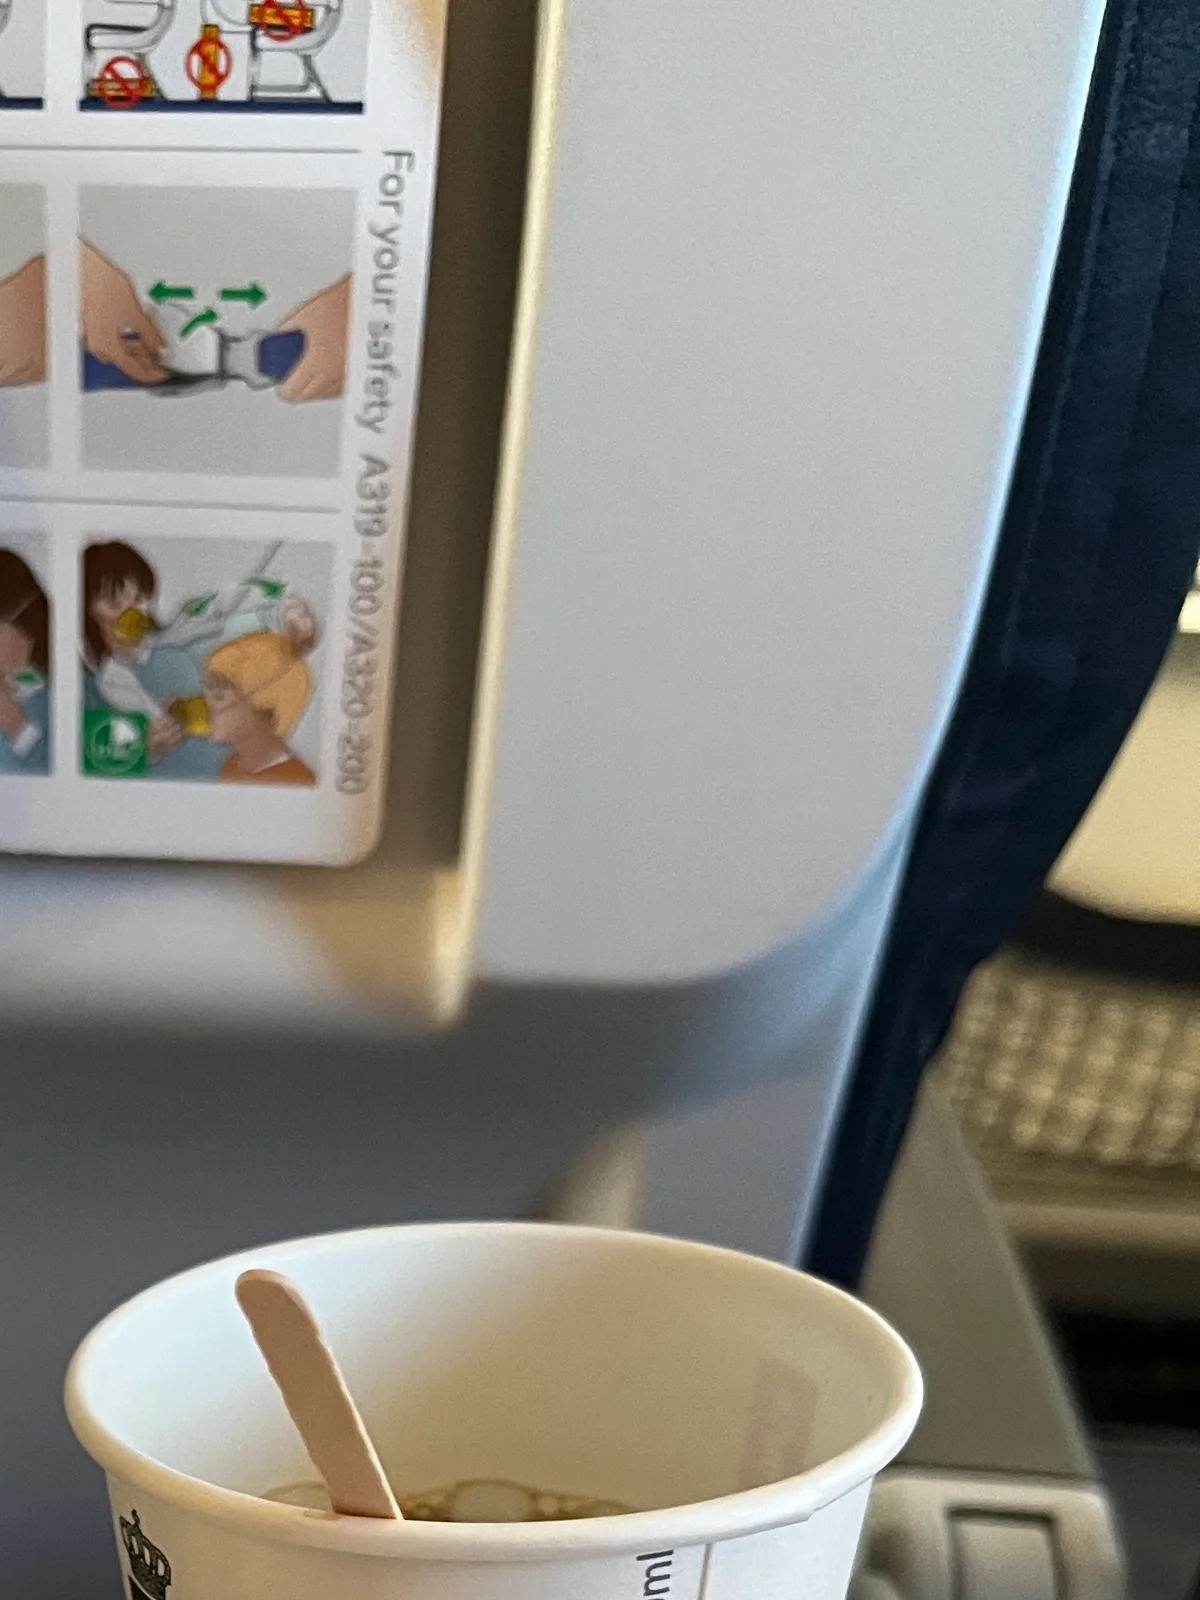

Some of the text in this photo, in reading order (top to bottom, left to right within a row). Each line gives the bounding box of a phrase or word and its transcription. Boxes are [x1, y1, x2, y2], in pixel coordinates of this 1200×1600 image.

[377, 151, 415, 217] For
[368, 222, 401, 314] your
[354, 320, 400, 435] safety
